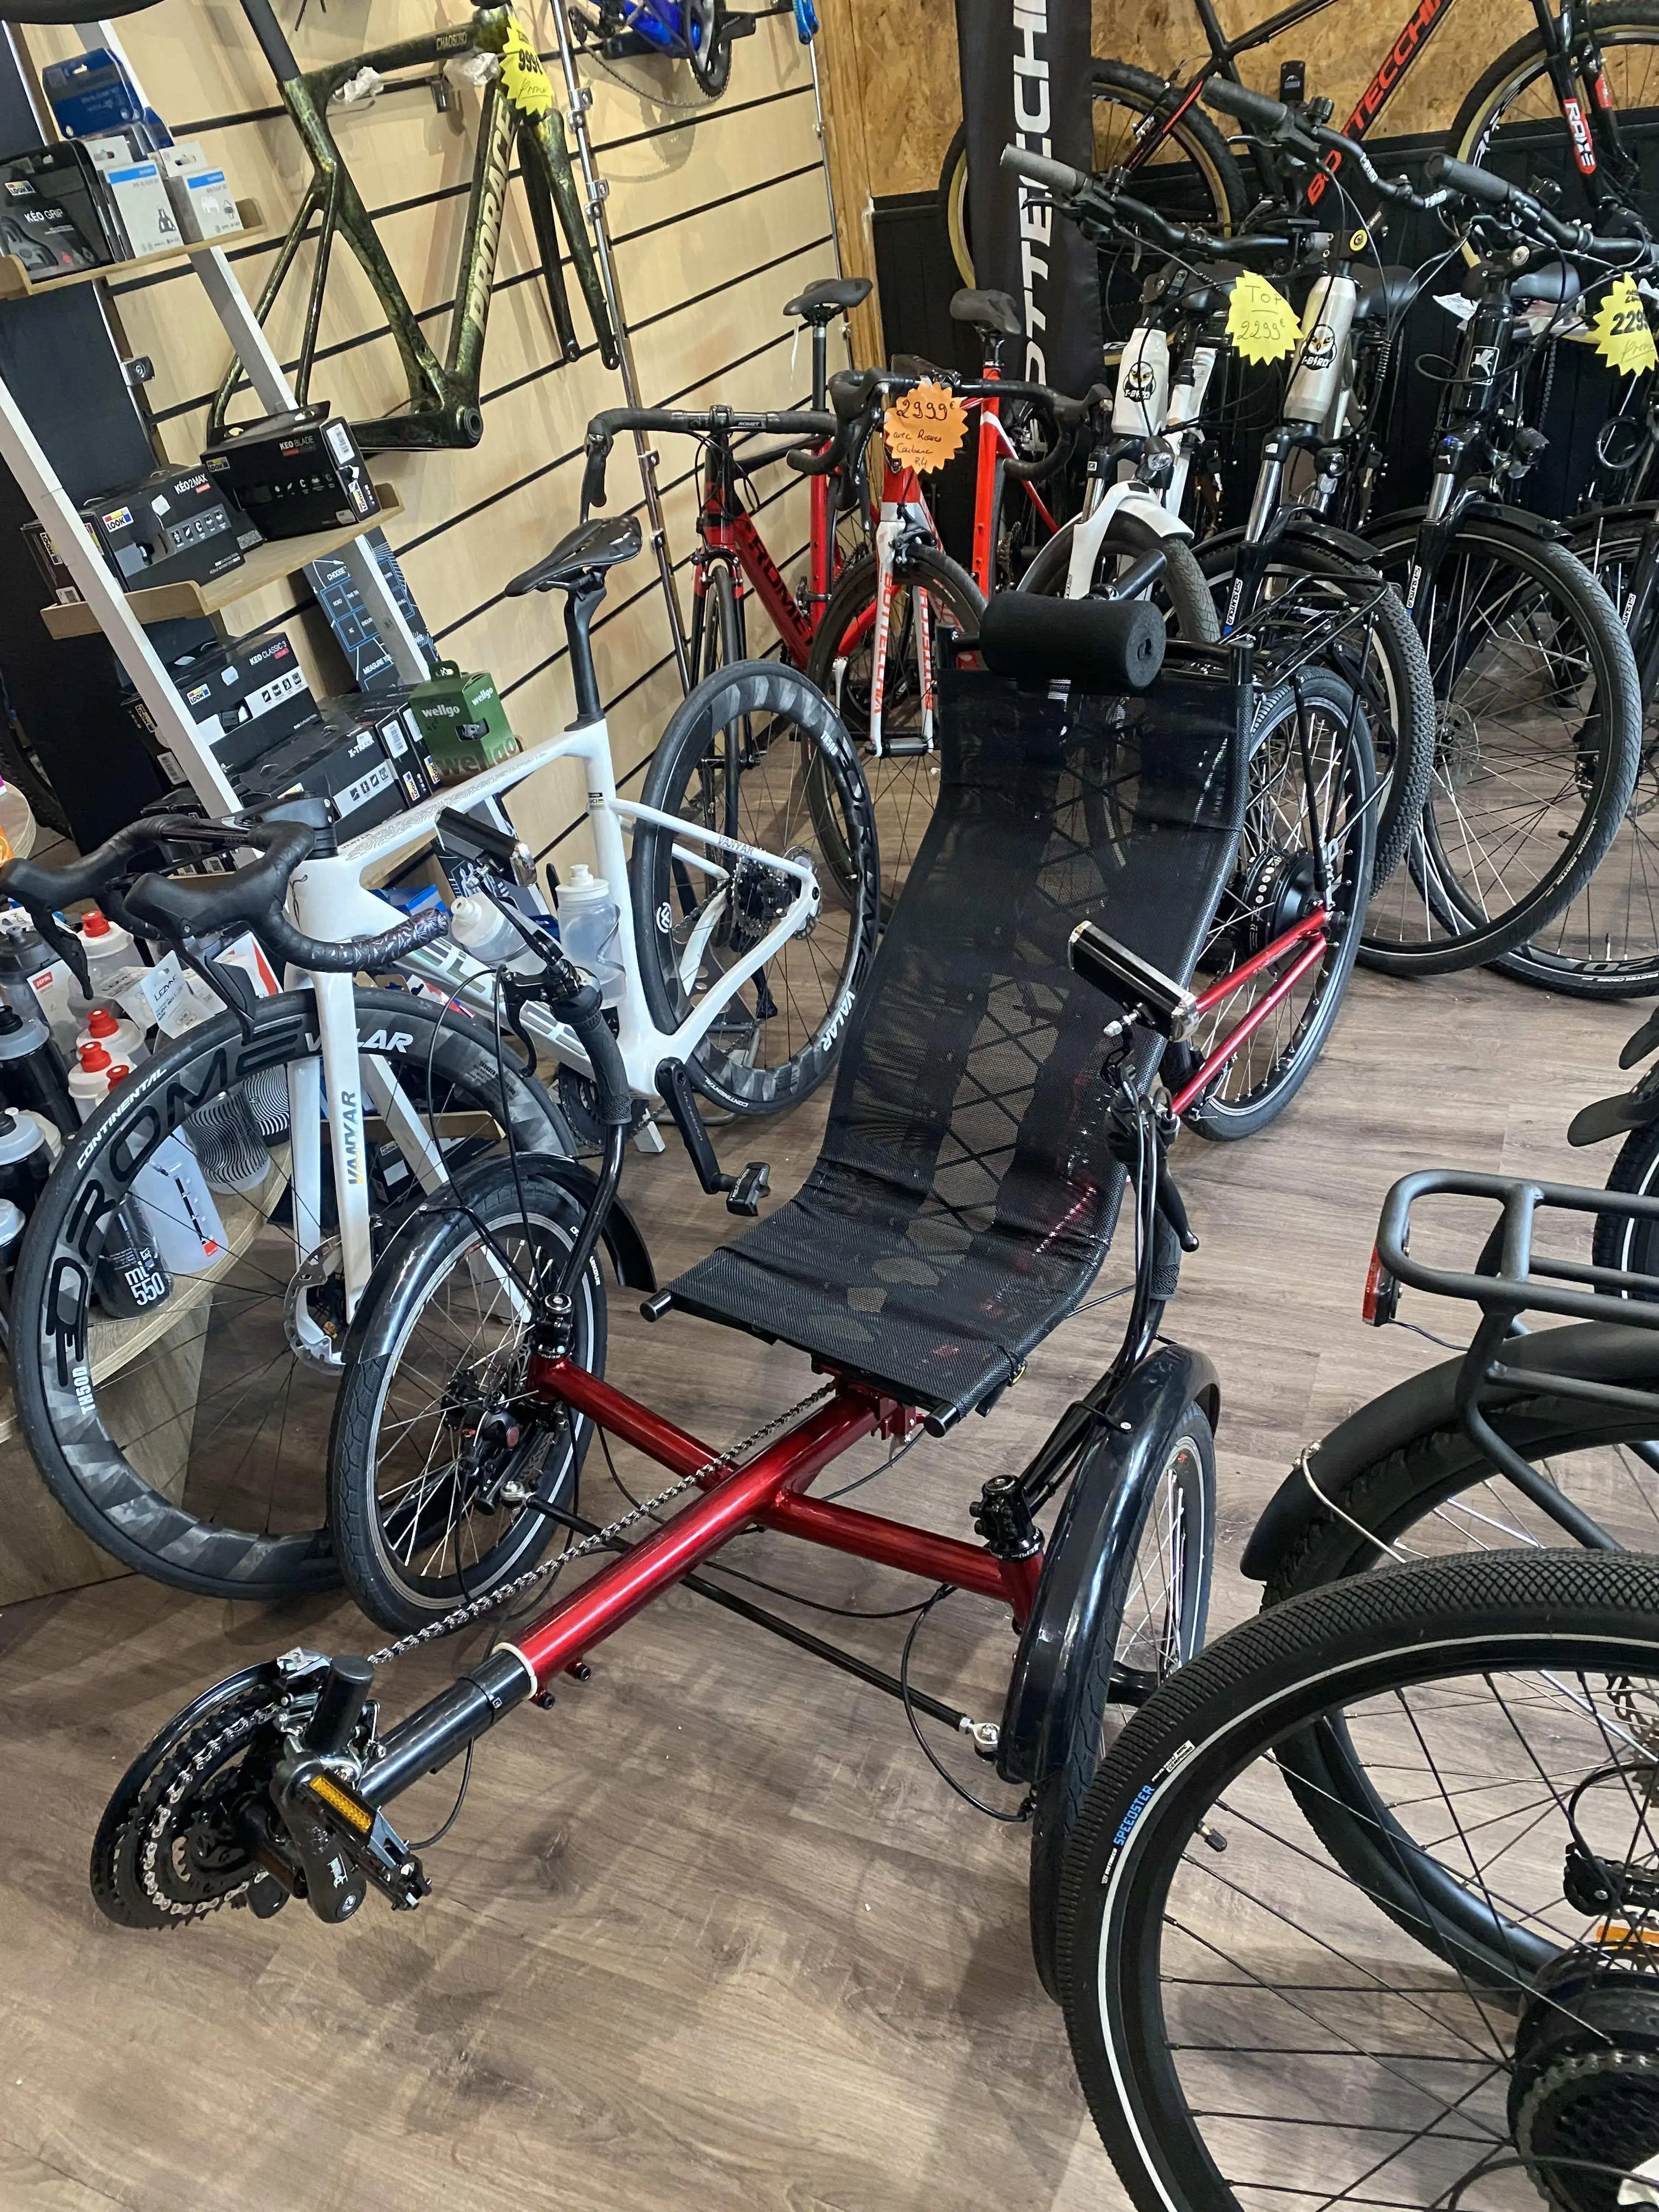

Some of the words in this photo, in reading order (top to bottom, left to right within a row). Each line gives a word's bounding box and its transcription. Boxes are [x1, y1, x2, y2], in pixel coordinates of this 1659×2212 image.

[24, 211, 44, 222] KÉO
[44, 208, 63, 219] GRIP
[294, 436, 314, 447] BLADE
[106, 517, 126, 530] LOOK
[1408, 577, 1418, 607] SUNTOUR
[1226, 589, 1240, 625] SUNTOUR
[249, 654, 263, 665] KEO
[262, 642, 282, 658] CLASSIC
[190, 692, 204, 703] LOOK
[472, 687, 493, 706] wellgo
[422, 704, 460, 718] wellgo
[822, 990, 856, 1052] VALAR
[304, 1028, 414, 1053] VLAR
[704, 1076, 749, 1107] CONTINENTAL
[76, 1065, 167, 1170] CONTINENTAL
[341, 1091, 364, 1185] VANYAR
[131, 1272, 165, 1306] 550
[1113, 1785, 1155, 1846] SPEEDSTER
